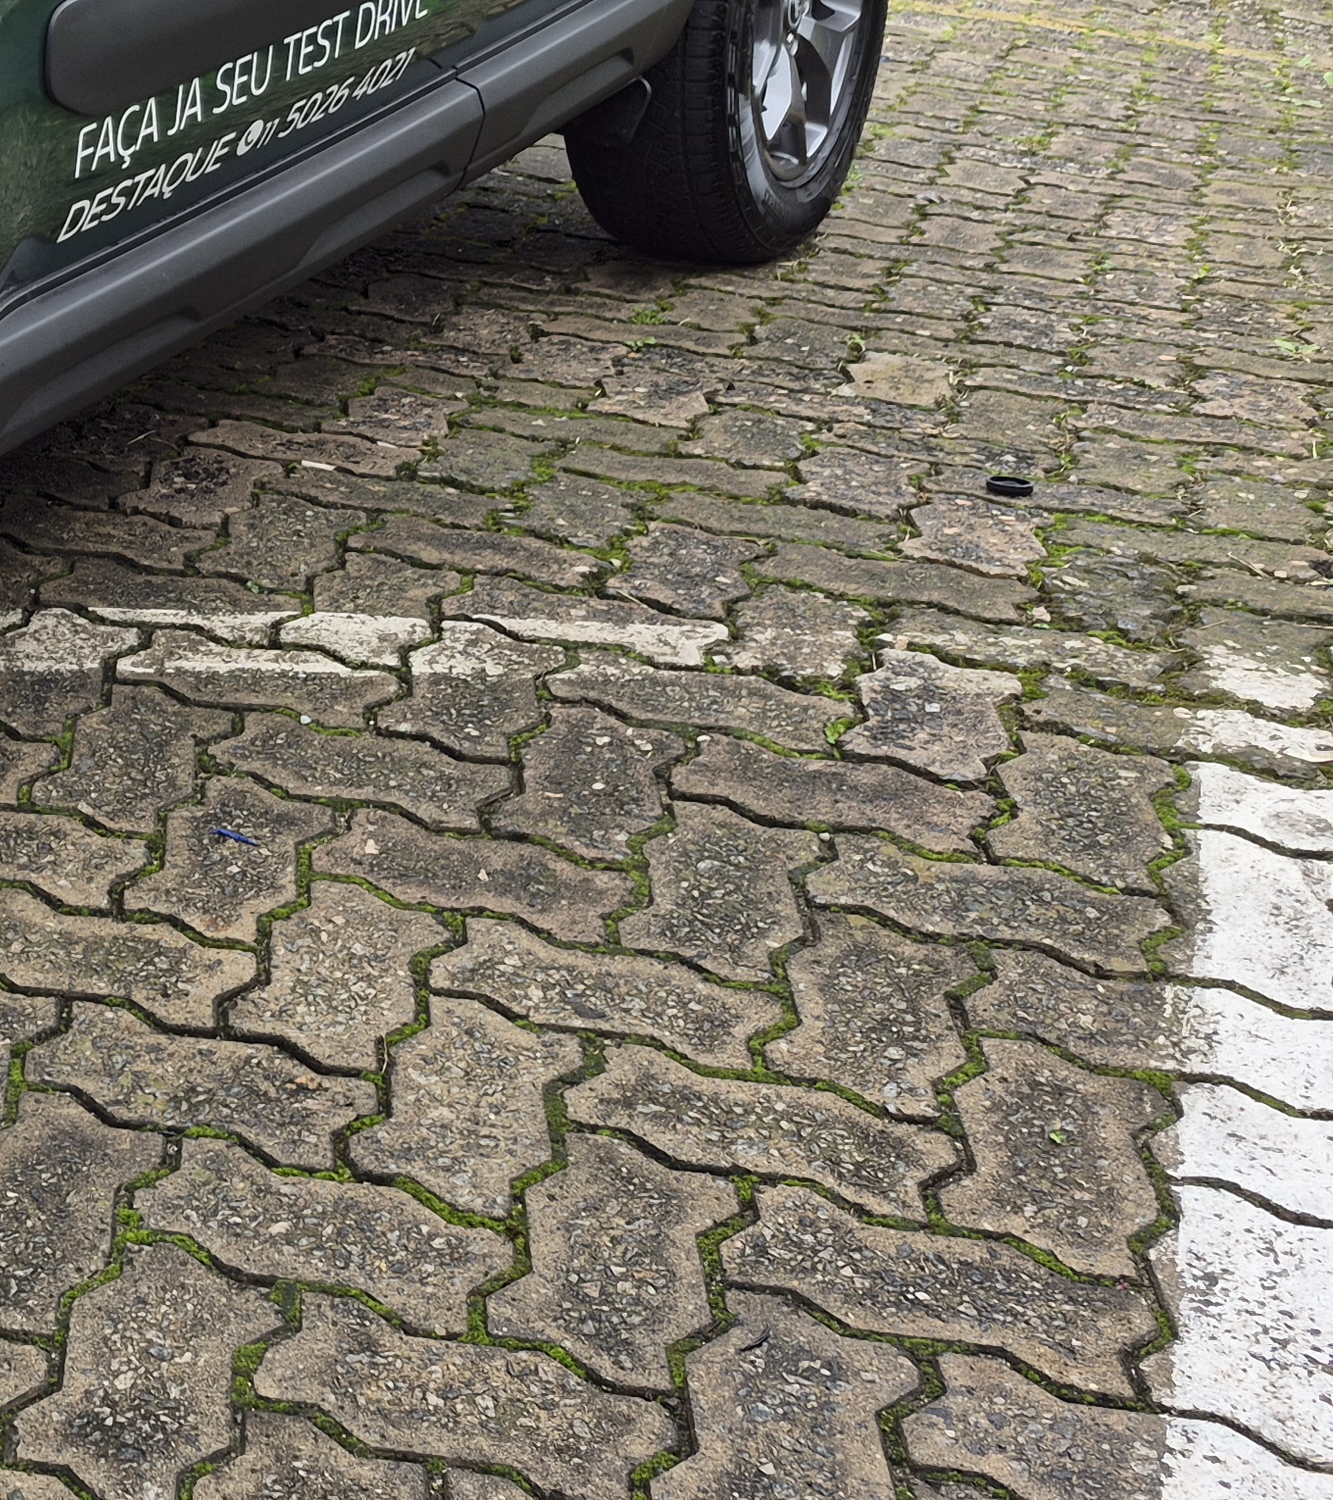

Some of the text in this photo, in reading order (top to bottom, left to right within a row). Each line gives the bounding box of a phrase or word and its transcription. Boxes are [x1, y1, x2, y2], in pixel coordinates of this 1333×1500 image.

[55, 130, 237, 244] DESTAQUE
[277, 76, 355, 140] 5026
[351, 46, 417, 101] 4021
[74, 96, 159, 179] FAÇA
[166, 76, 204, 137] JA
[211, 43, 275, 116] SEU
[282, 10, 351, 82] TEST
